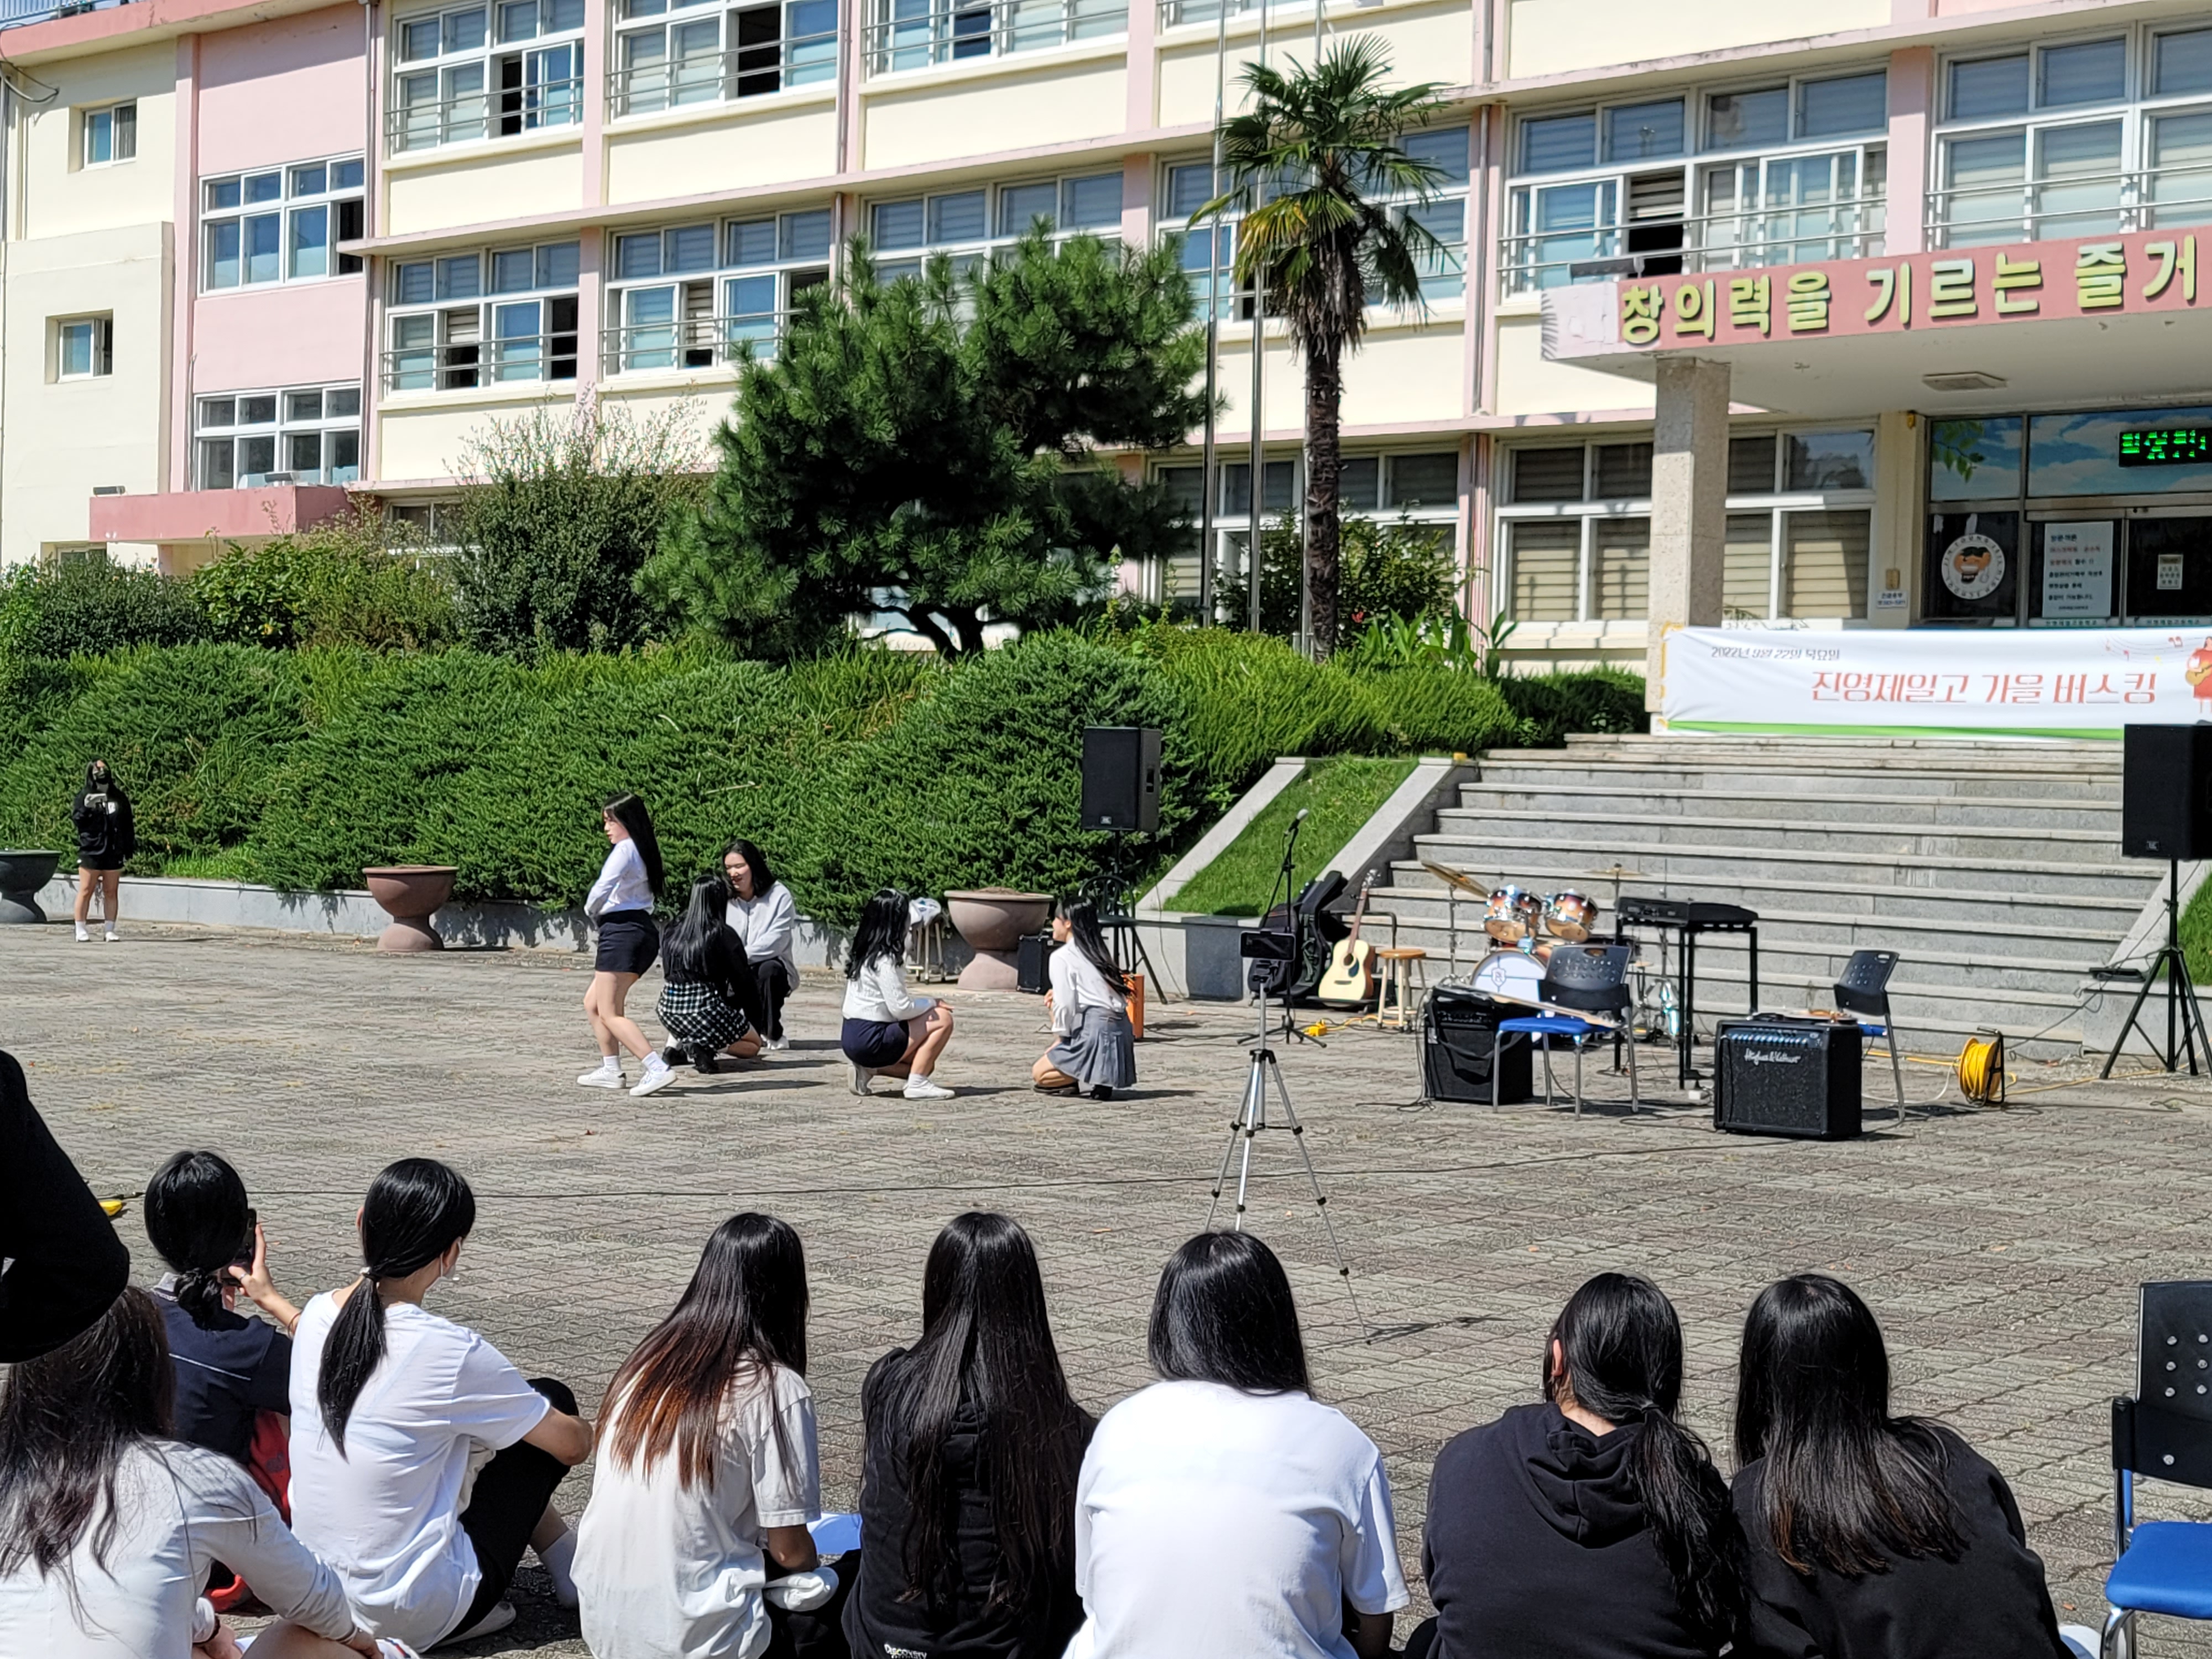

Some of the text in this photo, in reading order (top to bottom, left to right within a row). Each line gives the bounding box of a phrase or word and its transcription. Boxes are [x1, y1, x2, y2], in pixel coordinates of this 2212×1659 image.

[1621, 234, 2196, 345] 창의력을 기르는 즐거
[1711, 646, 1751, 659] 2022년
[1806, 648, 1840, 660] 목요일
[1811, 671, 2157, 705] 진영제일고 가을 버스킹
